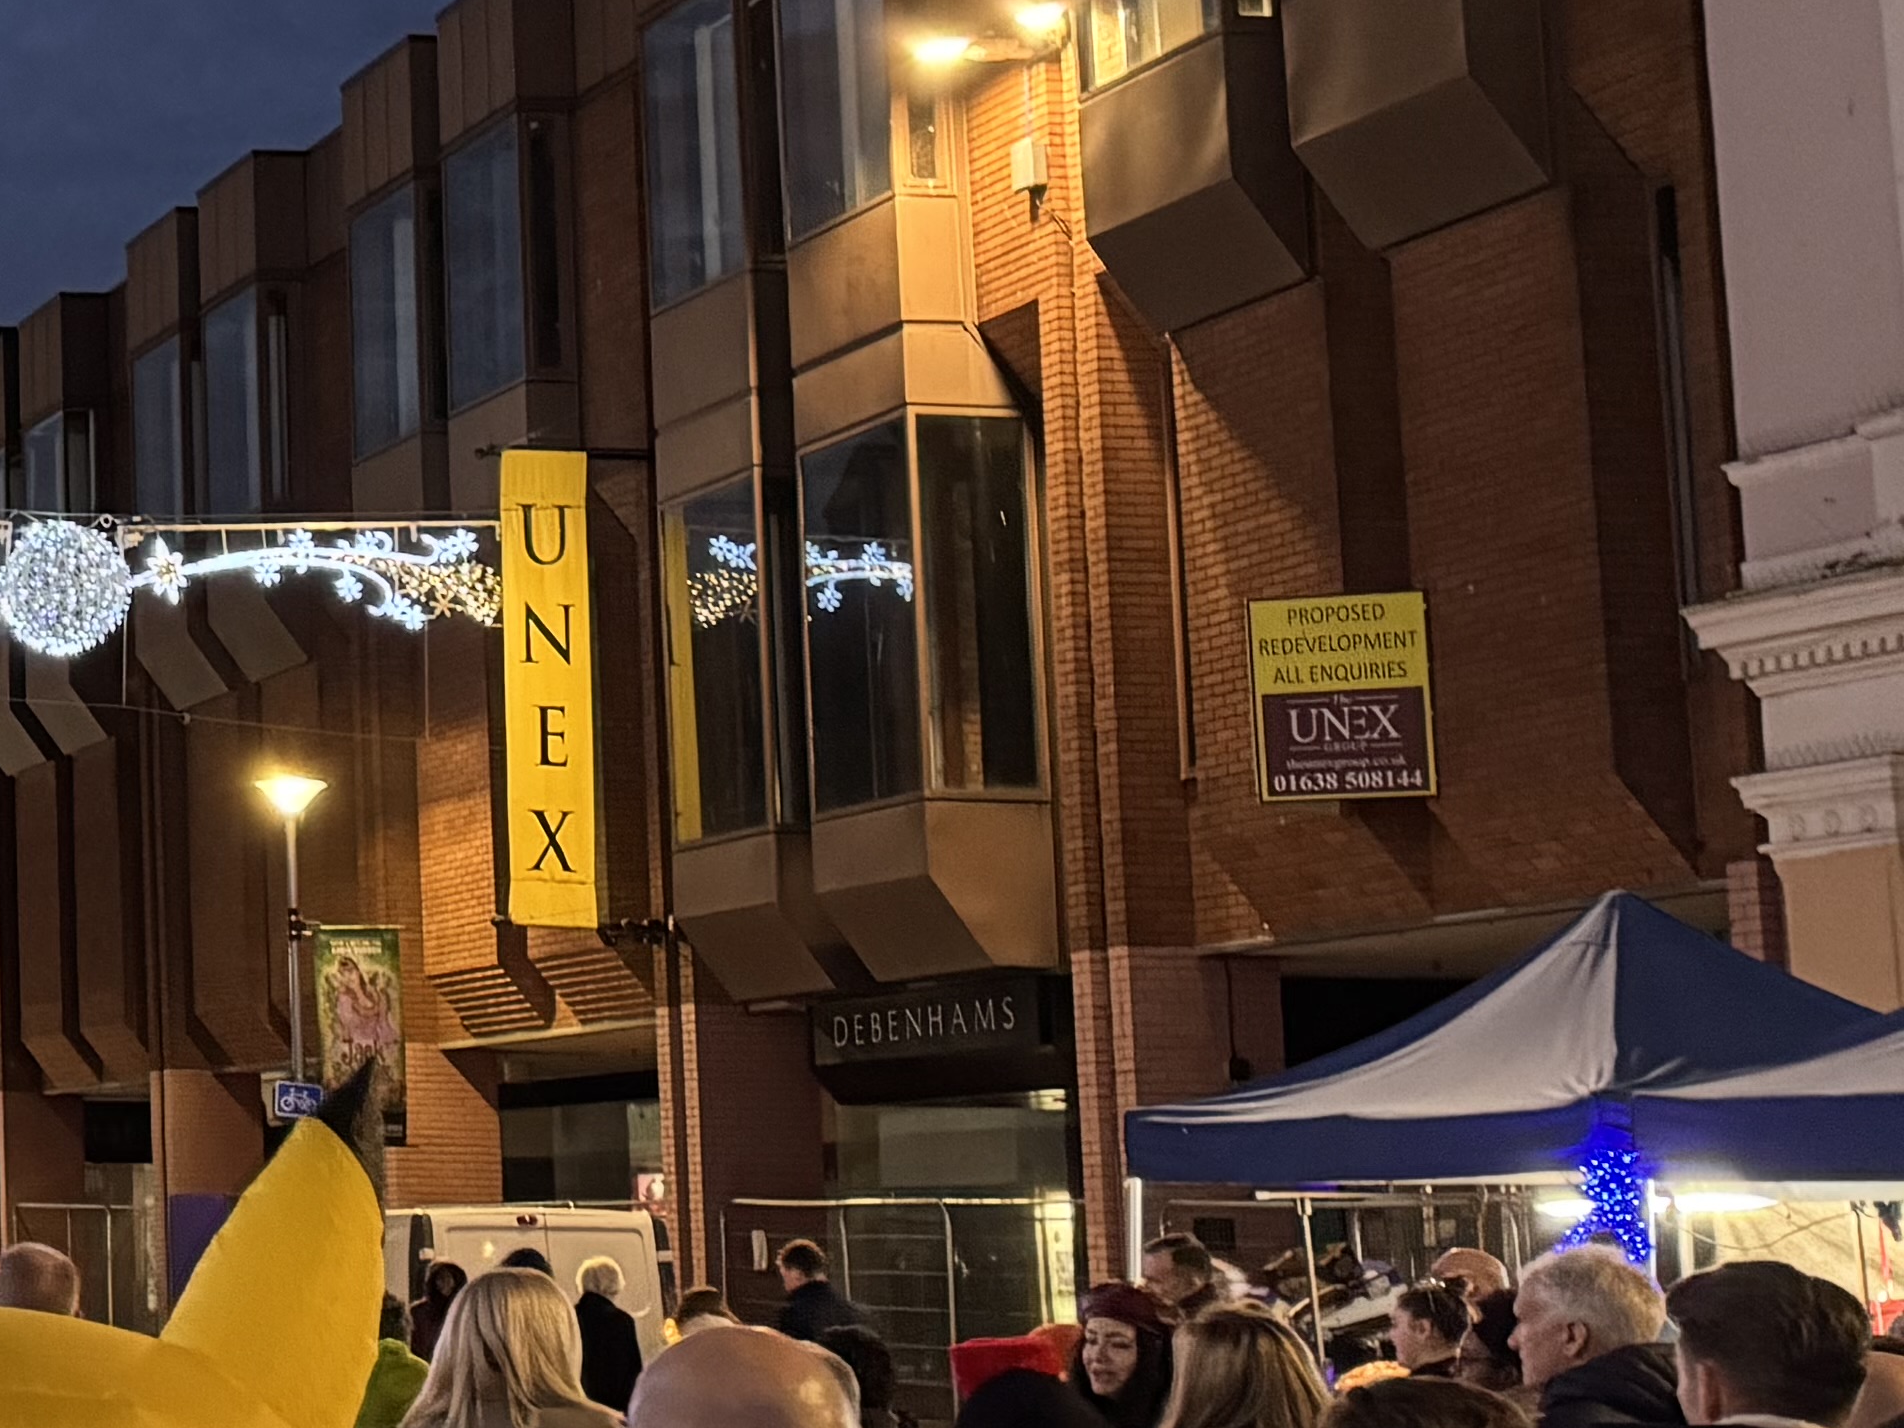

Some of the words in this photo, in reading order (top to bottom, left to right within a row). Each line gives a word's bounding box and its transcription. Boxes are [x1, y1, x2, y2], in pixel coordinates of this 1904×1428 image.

[1287, 603, 1386, 626] PROPOSED
[1258, 629, 1419, 657] REDEVELOPMENT
[1273, 665, 1304, 685] ALL
[1310, 660, 1409, 683] ENQUIRIES
[515, 503, 577, 873] UNEX
[1288, 704, 1403, 744] UNEX
[1273, 772, 1339, 792] 01638
[1344, 768, 1424, 790] 508144
[833, 995, 1016, 1048] DEBENHAMS
